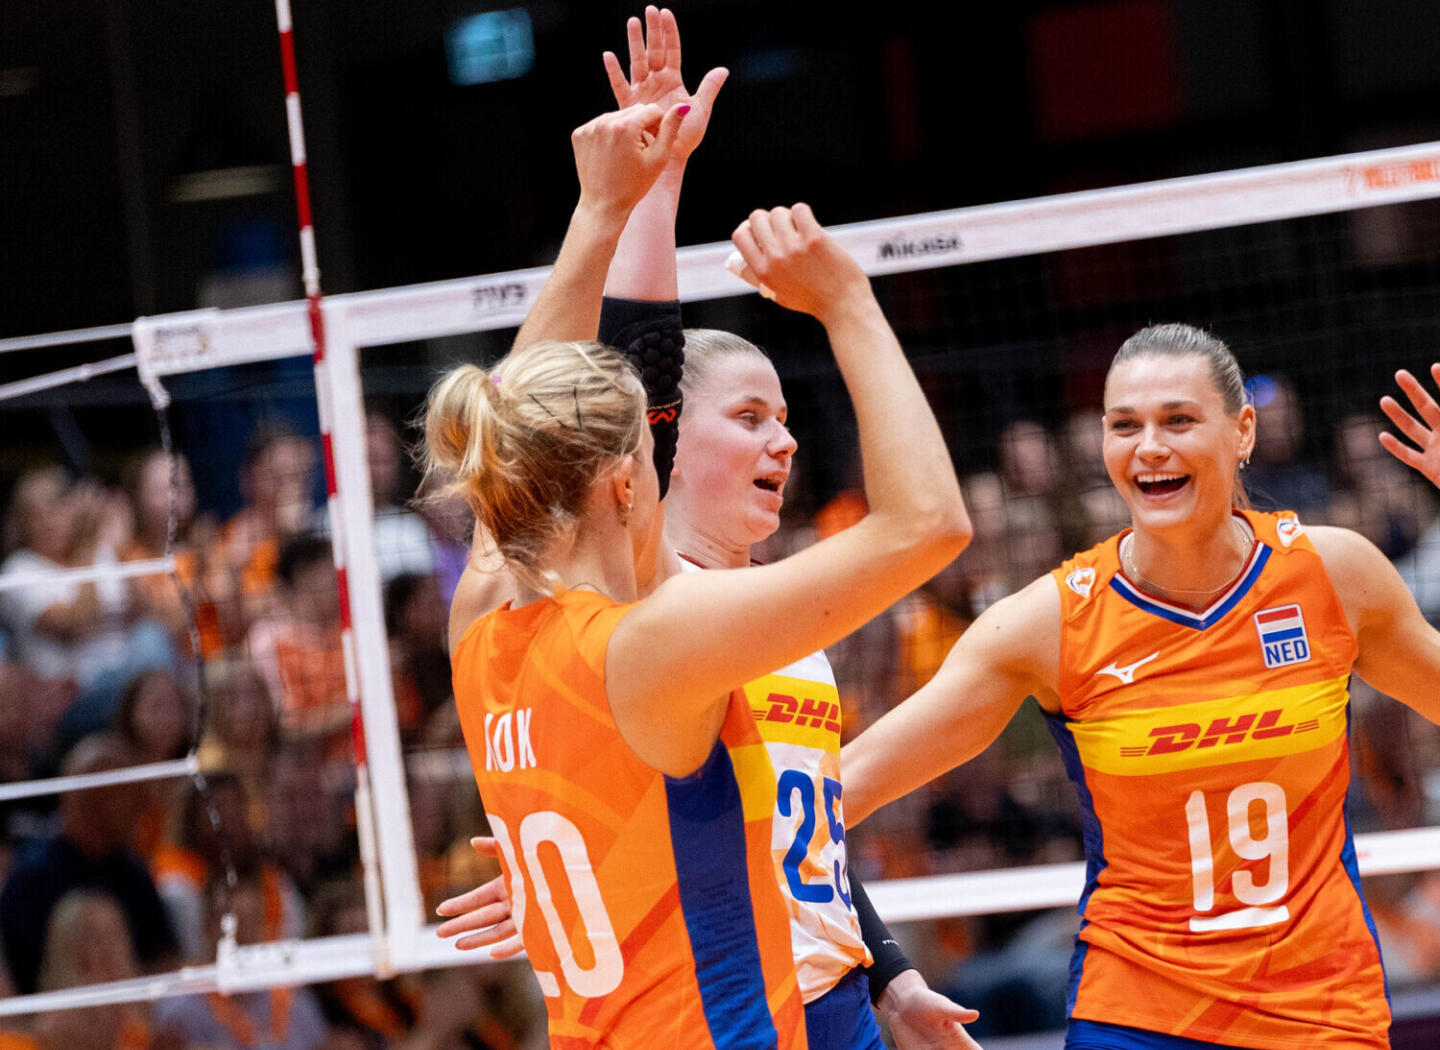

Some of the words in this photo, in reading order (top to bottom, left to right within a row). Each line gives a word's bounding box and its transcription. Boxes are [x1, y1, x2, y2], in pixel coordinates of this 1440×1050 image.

[1264, 639, 1309, 666] NED
[765, 692, 840, 734] DHL
[1147, 708, 1294, 756] DHL
[777, 769, 851, 912] 25
[1185, 781, 1289, 912] 19
